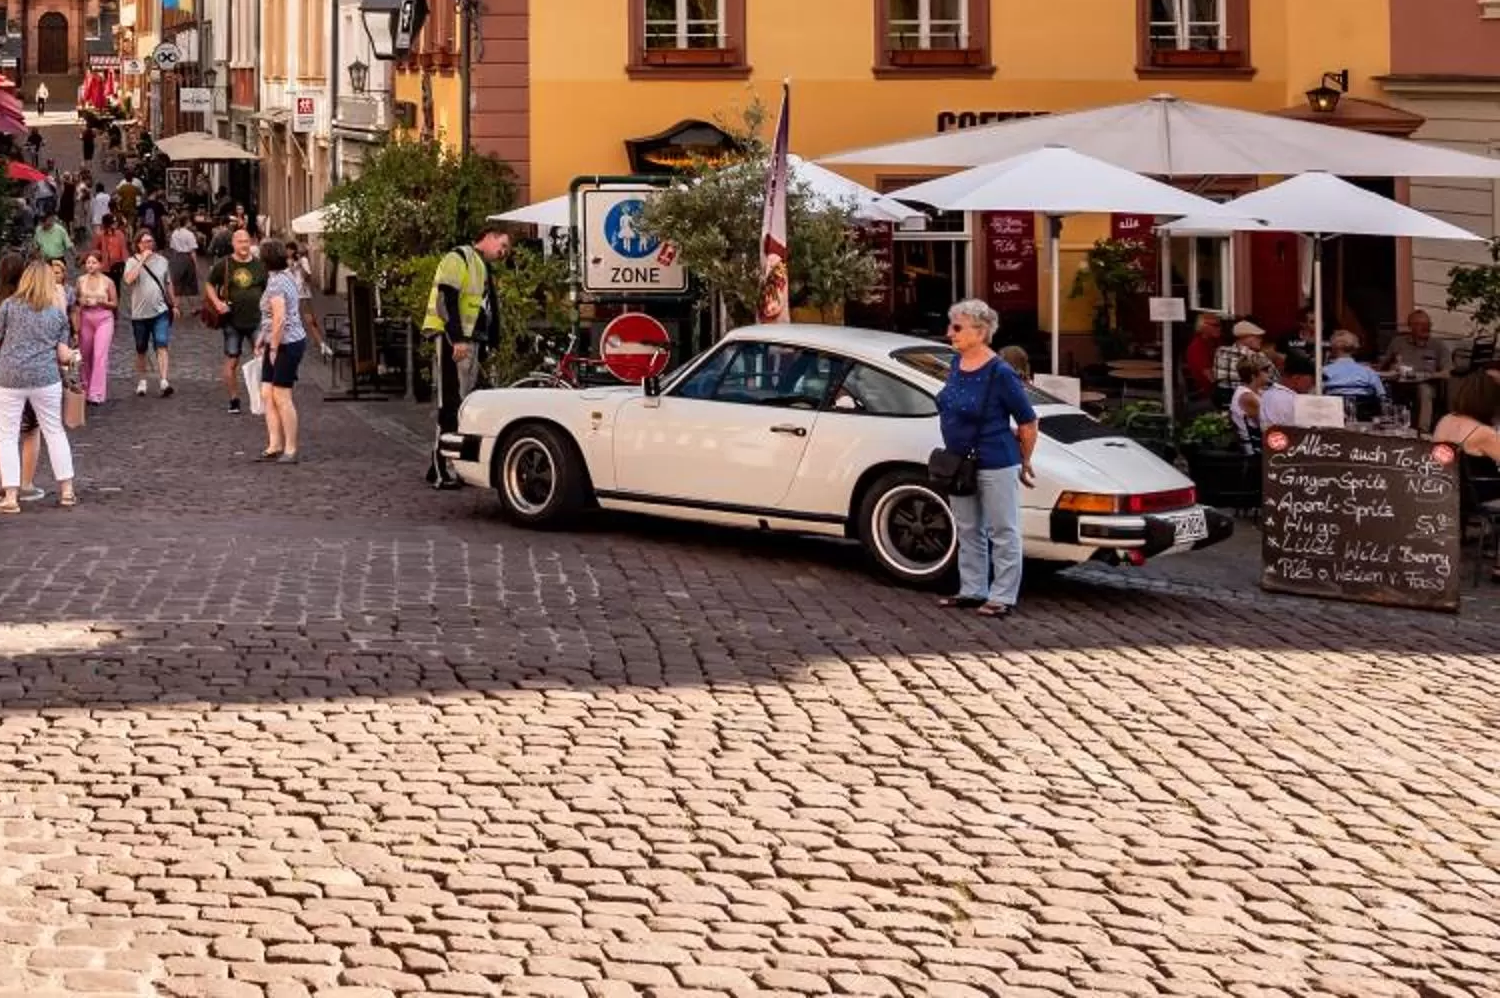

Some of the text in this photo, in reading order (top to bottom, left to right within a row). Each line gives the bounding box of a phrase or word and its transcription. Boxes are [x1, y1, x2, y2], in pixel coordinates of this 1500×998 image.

[611, 267, 660, 283] ZONE
[1288, 433, 1341, 458] Alles
[1349, 445, 1387, 464] auch
[1283, 515, 1341, 544] Hugo
[1344, 540, 1394, 563] Wild
[1400, 546, 1451, 577] Berry
